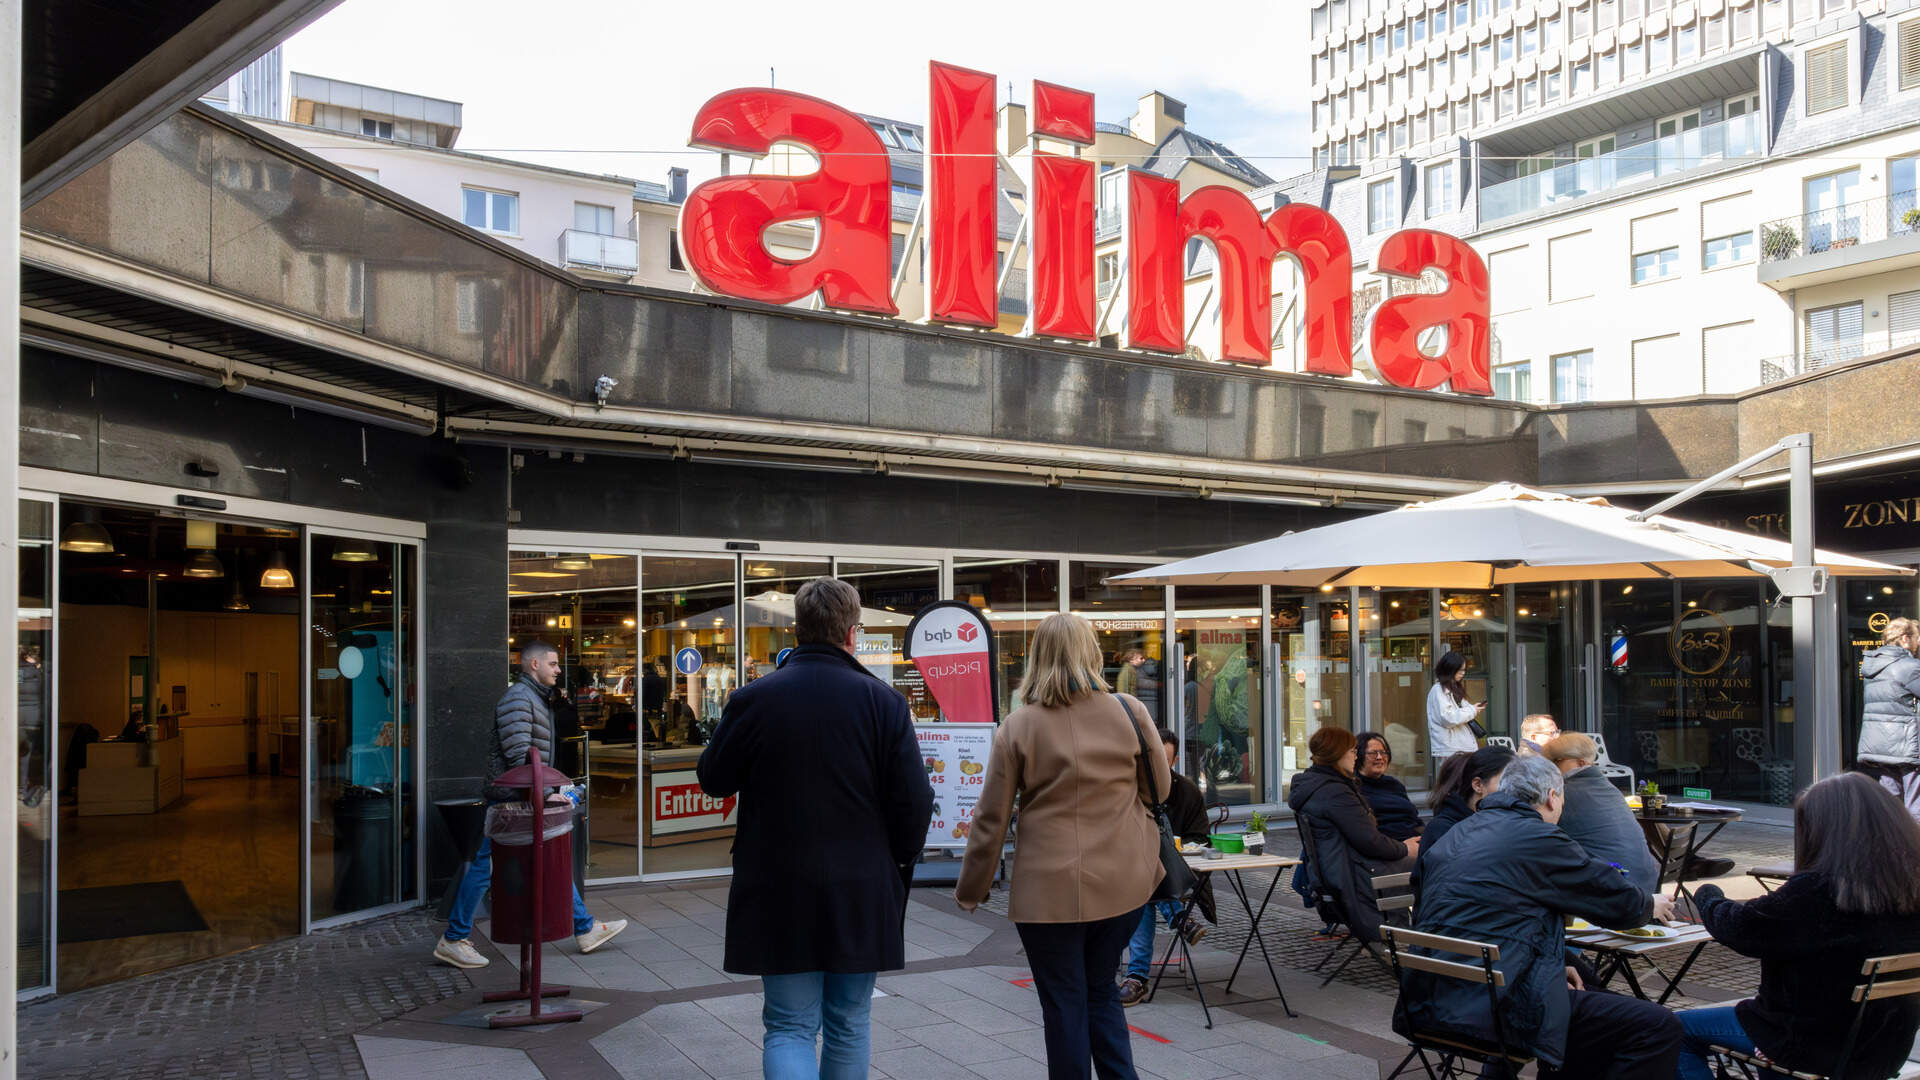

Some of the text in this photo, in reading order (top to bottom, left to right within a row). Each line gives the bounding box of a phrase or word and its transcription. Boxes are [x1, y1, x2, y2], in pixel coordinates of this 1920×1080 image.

[679, 60, 1494, 396] alima
[1200, 630, 1243, 644] alima
[1692, 679, 1718, 688] STOP
[1722, 678, 1751, 688] ZONE
[916, 731, 951, 742] alima
[959, 775, 984, 785] 1,05
